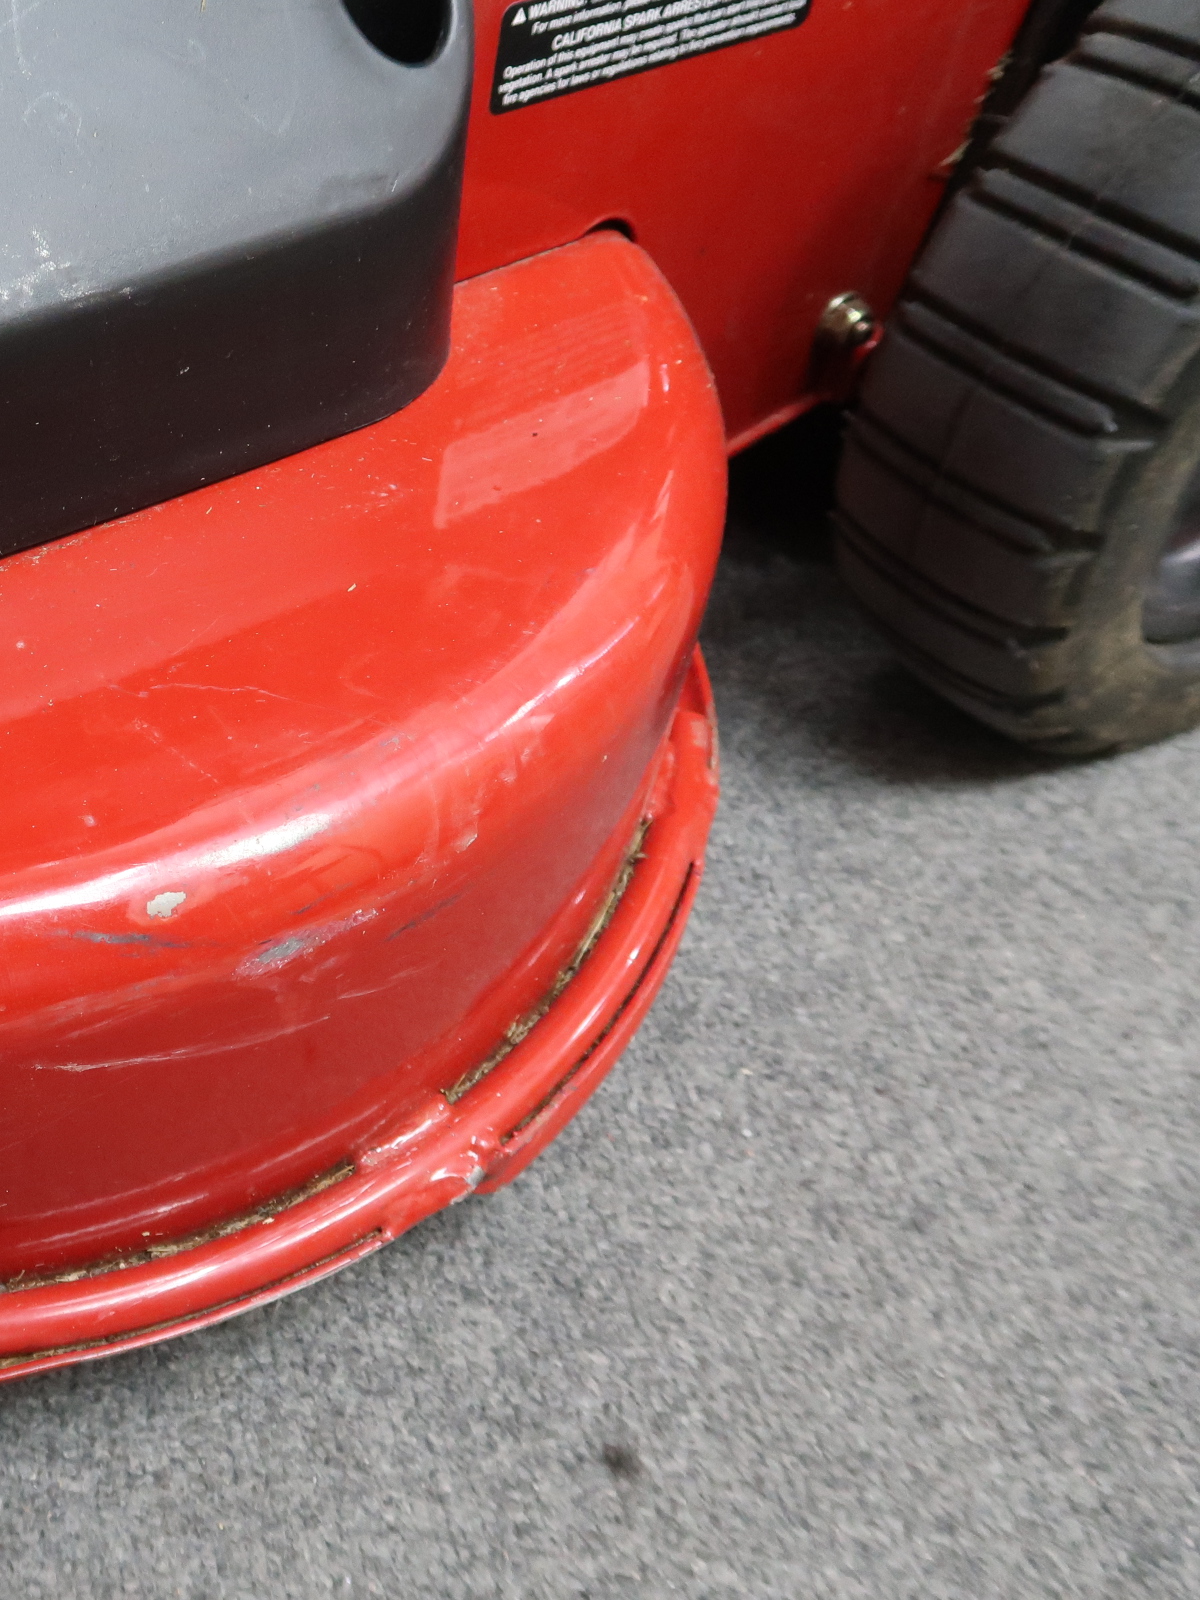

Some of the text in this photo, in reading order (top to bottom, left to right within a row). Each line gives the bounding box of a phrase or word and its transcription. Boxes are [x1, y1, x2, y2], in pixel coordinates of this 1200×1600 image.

[531, 21, 548, 35] For
[547, 15, 573, 31] more
[551, 18, 622, 51] CALIFORNIA
[622, 6, 664, 31] SPARK
[503, 58, 547, 80] Operation
[546, 52, 558, 67] of
[557, 49, 574, 62] this
[574, 35, 620, 59] equipment
[544, 67, 553, 80] A
[552, 61, 577, 79] spark
[502, 93, 519, 106] fire
[518, 81, 557, 103] agencies
[557, 77, 570, 89] for
[569, 73, 591, 87] laws
[591, 69, 602, 81] or
